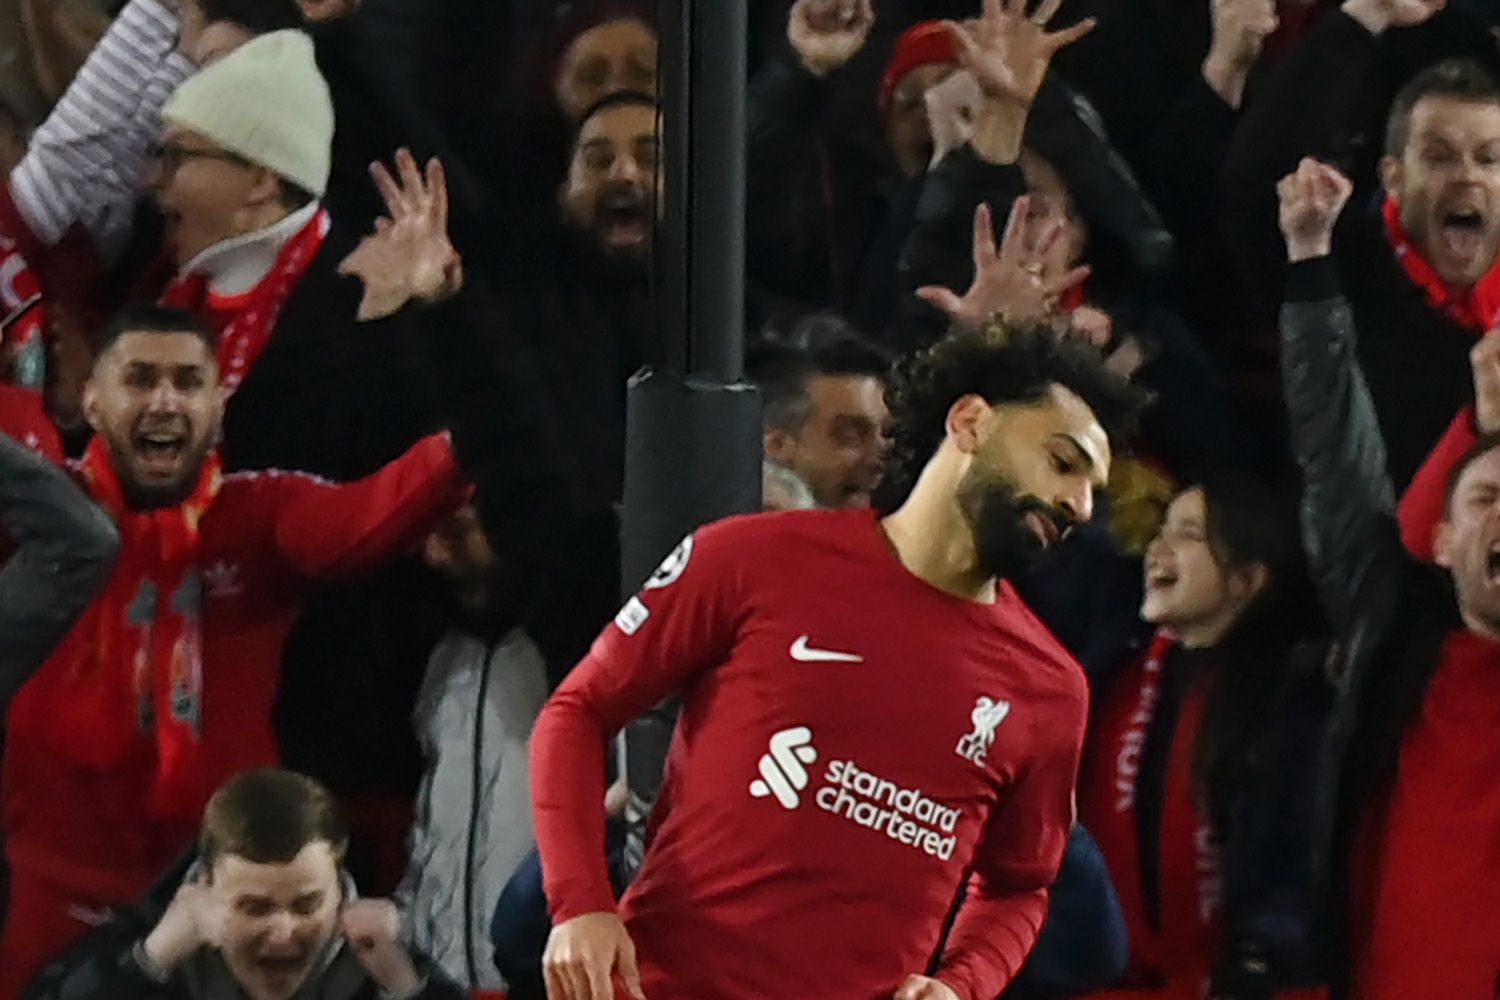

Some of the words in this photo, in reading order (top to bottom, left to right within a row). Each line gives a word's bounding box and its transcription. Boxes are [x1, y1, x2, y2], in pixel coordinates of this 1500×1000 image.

[955, 732, 988, 768] LFC
[816, 787, 956, 861] chartered
[825, 760, 961, 832] standard
